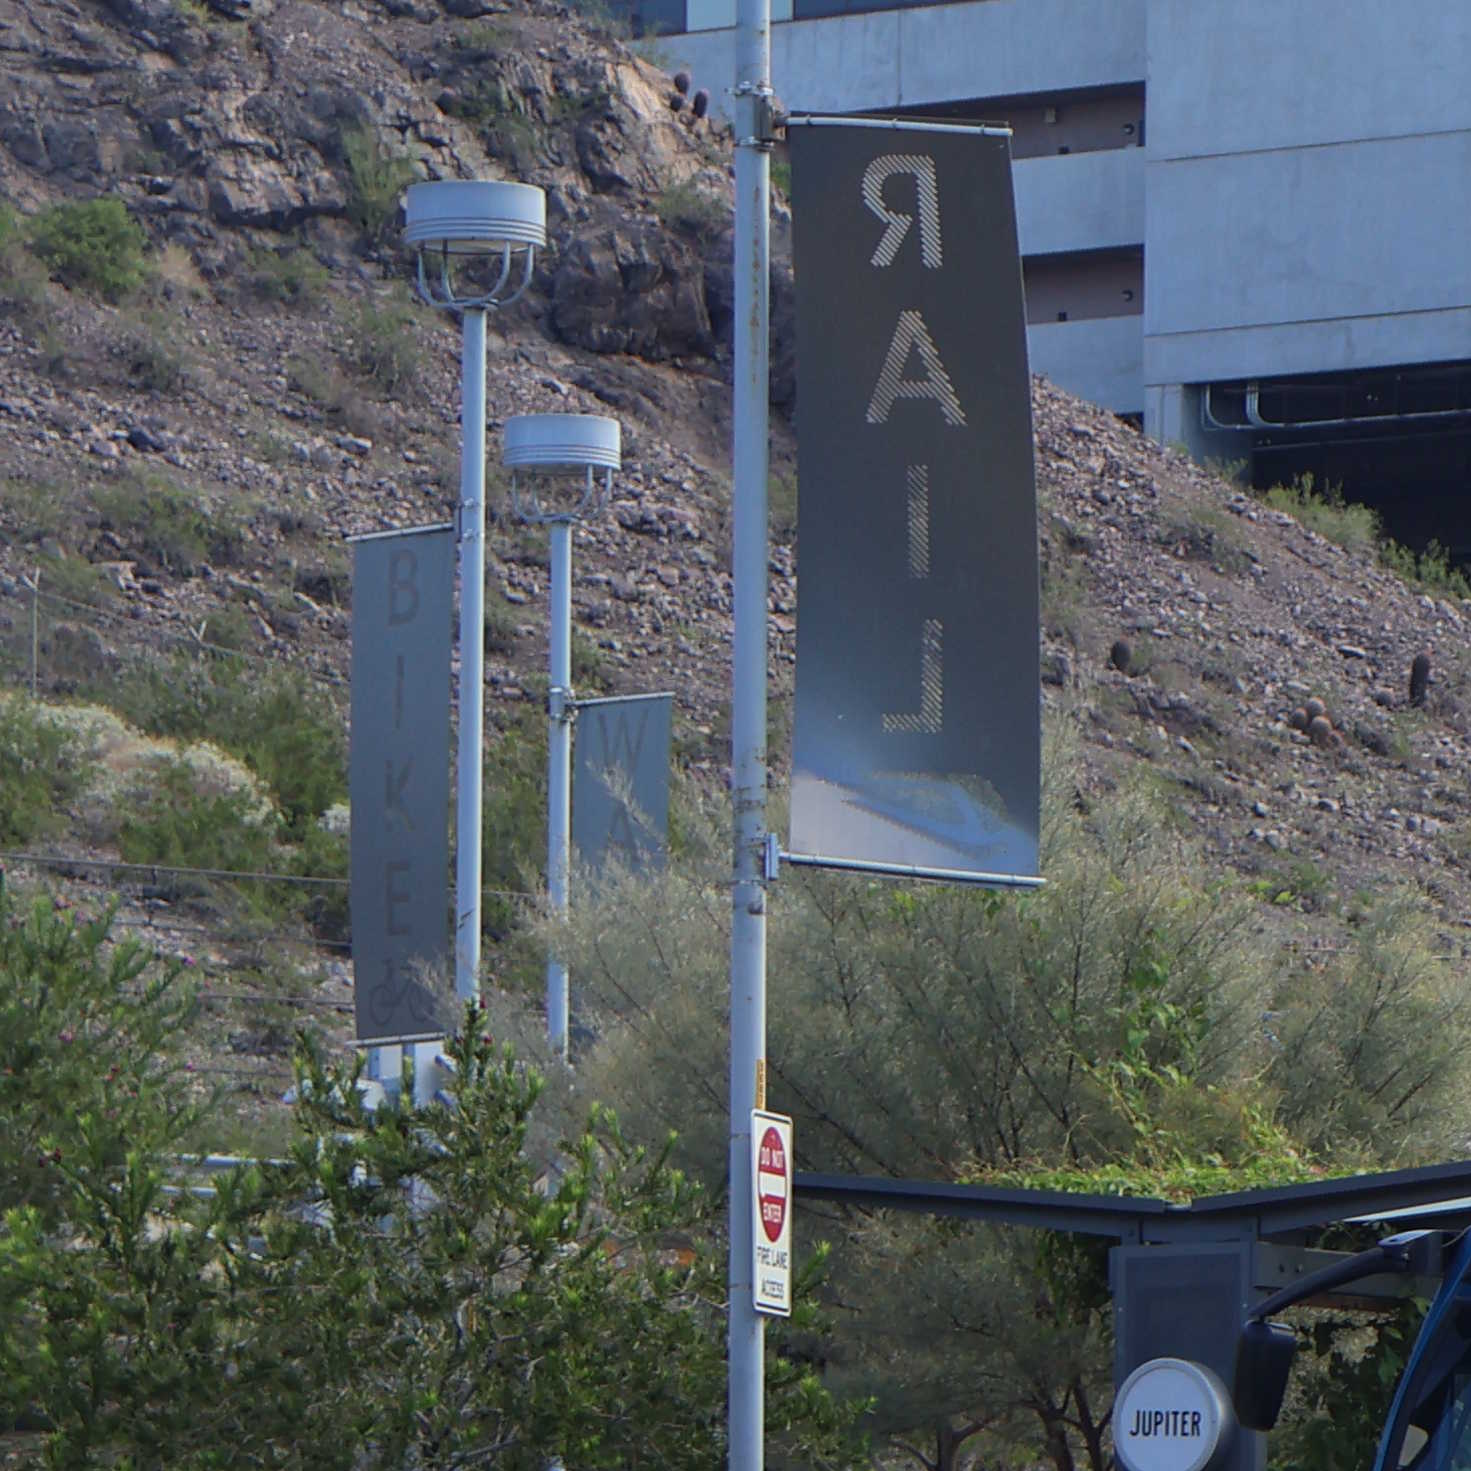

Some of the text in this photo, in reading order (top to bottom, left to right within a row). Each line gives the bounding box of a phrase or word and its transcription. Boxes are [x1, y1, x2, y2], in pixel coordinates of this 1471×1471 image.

[383, 548, 420, 938] BIKE
[760, 1146, 785, 1169] DO NOT
[762, 1202, 783, 1224] ENTER
[757, 1246, 788, 1270] FIRE LANE
[1129, 1410, 1202, 1436] JUPITER
